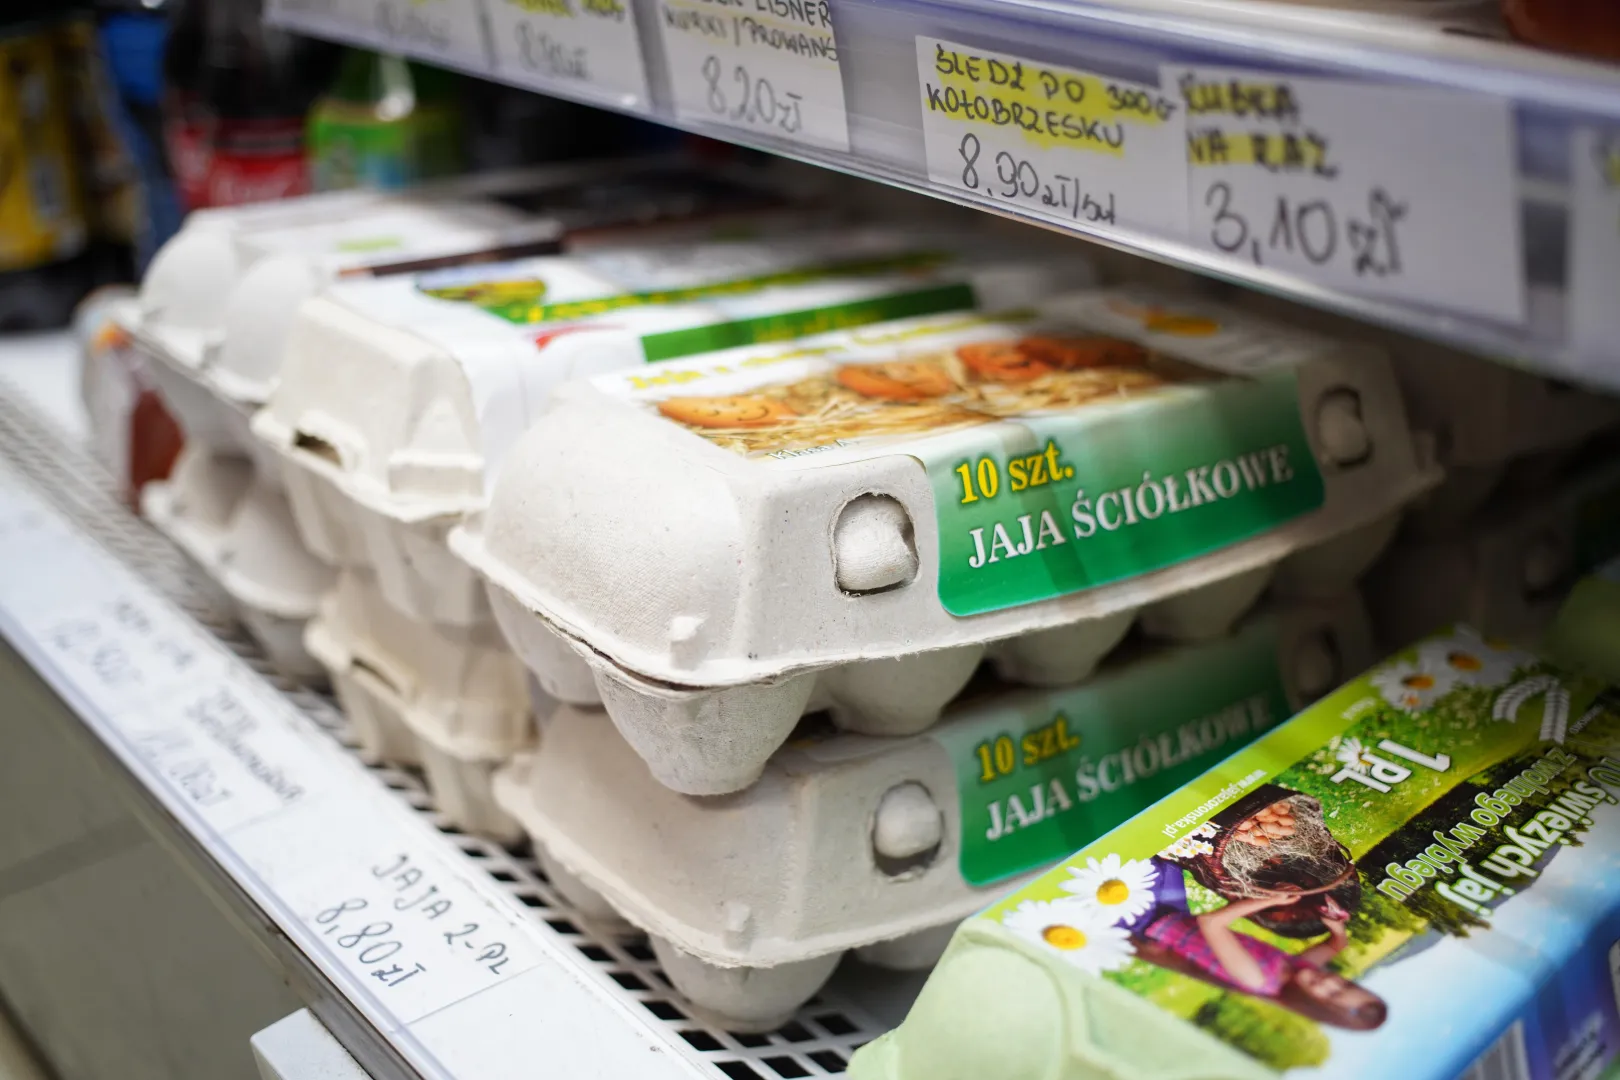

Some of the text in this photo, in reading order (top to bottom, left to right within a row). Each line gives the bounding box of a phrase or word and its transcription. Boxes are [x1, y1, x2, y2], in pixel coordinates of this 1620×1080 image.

[926, 82, 1124, 149] KOŁOBRZESKU
[1038, 70, 1085, 103] PO
[955, 438, 1075, 504] 10 szt.
[968, 443, 1295, 569] JAJA ŚCIÓŁKOWE
[974, 711, 1080, 783] 10 szt.
[985, 695, 1274, 841] JAJA ŚCIÓŁKOWE
[1161, 767, 1270, 839] www.jajazoronska.pl
[1479, 779, 1619, 878] świeżych
[1376, 821, 1487, 903] wybiegu
[1433, 862, 1516, 918] jaj
[371, 853, 510, 976] JAJA 2-PL
